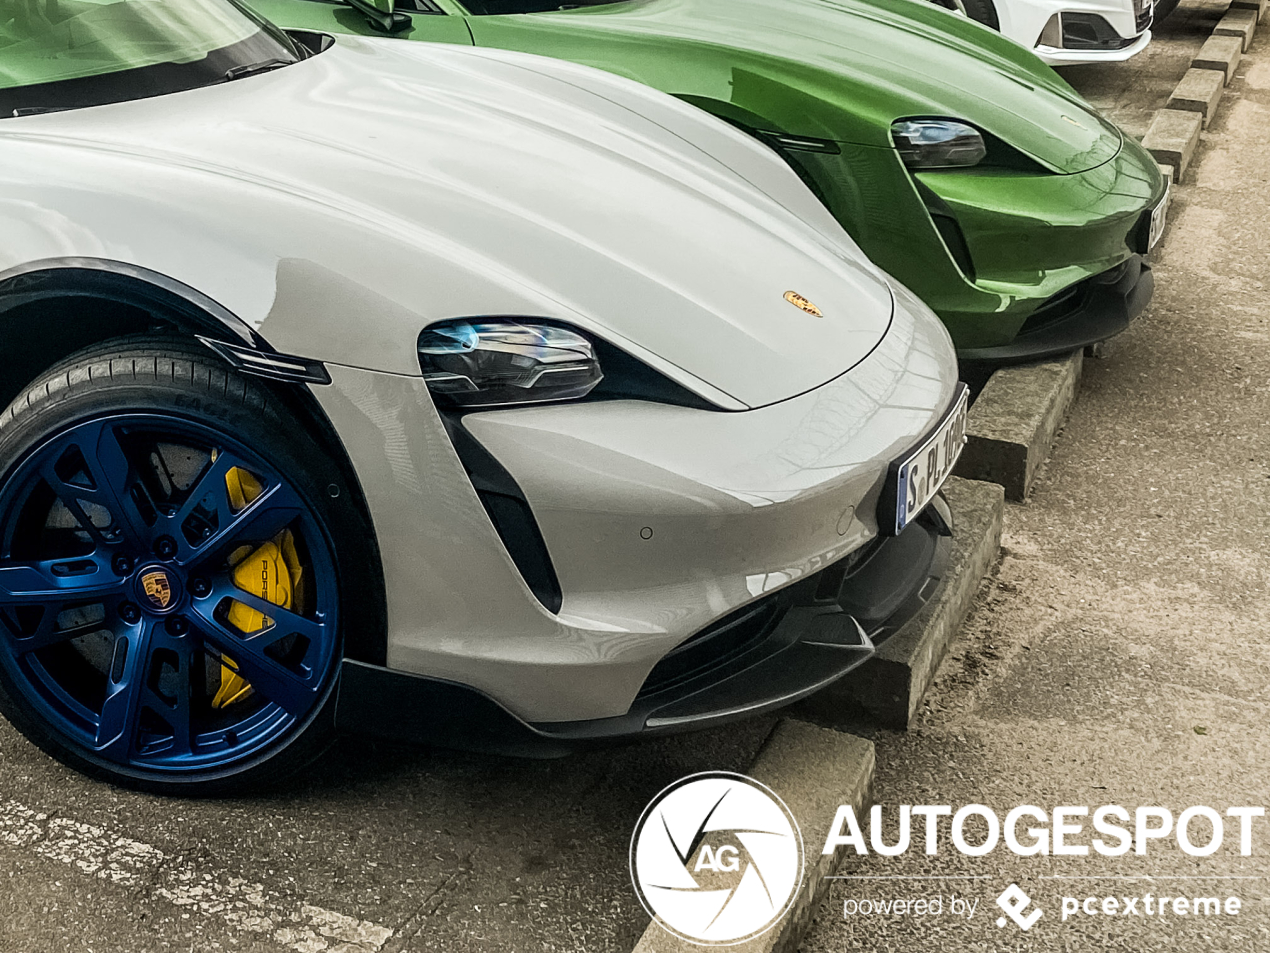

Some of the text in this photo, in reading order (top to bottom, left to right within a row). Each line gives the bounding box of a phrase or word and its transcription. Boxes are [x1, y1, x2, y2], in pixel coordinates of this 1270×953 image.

[908, 464, 918, 514] S
[926, 442, 940, 496] PL
[261, 559, 269, 629] PORSHE
